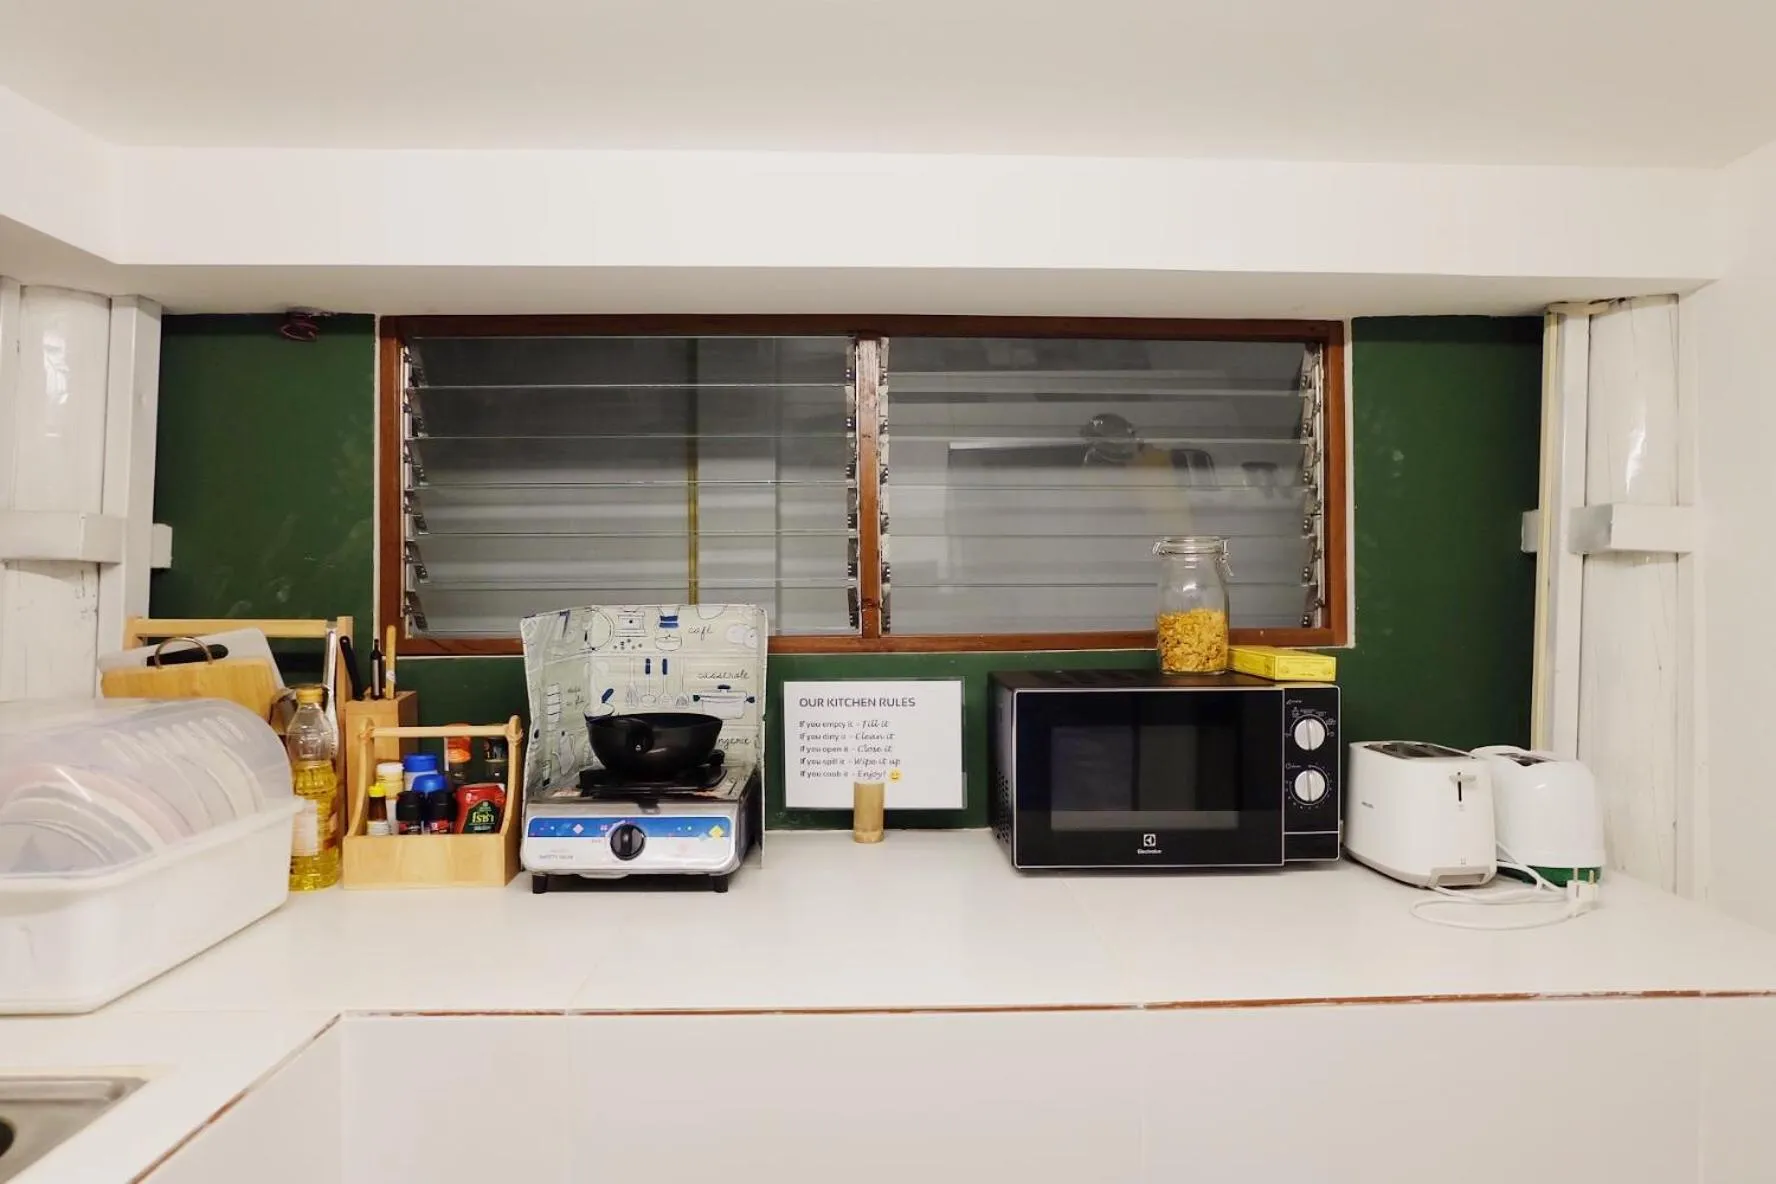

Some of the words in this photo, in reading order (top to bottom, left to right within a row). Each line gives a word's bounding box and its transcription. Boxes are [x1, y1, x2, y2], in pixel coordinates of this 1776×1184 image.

[799, 698, 824, 708] OUR
[827, 698, 876, 708] KITCHEN
[879, 698, 916, 708] RULES
[799, 720, 806, 728] If
[822, 721, 846, 729] empty
[848, 720, 854, 728] it
[799, 732, 806, 740] If
[855, 731, 885, 740] Clean
[799, 744, 805, 752] If
[857, 744, 882, 753] Close
[806, 758, 821, 766] you
[822, 757, 838, 766] spill
[854, 757, 878, 767] Wipe
[889, 758, 901, 768] up
[807, 771, 822, 779] you
[857, 770, 887, 780] Enjoy!
